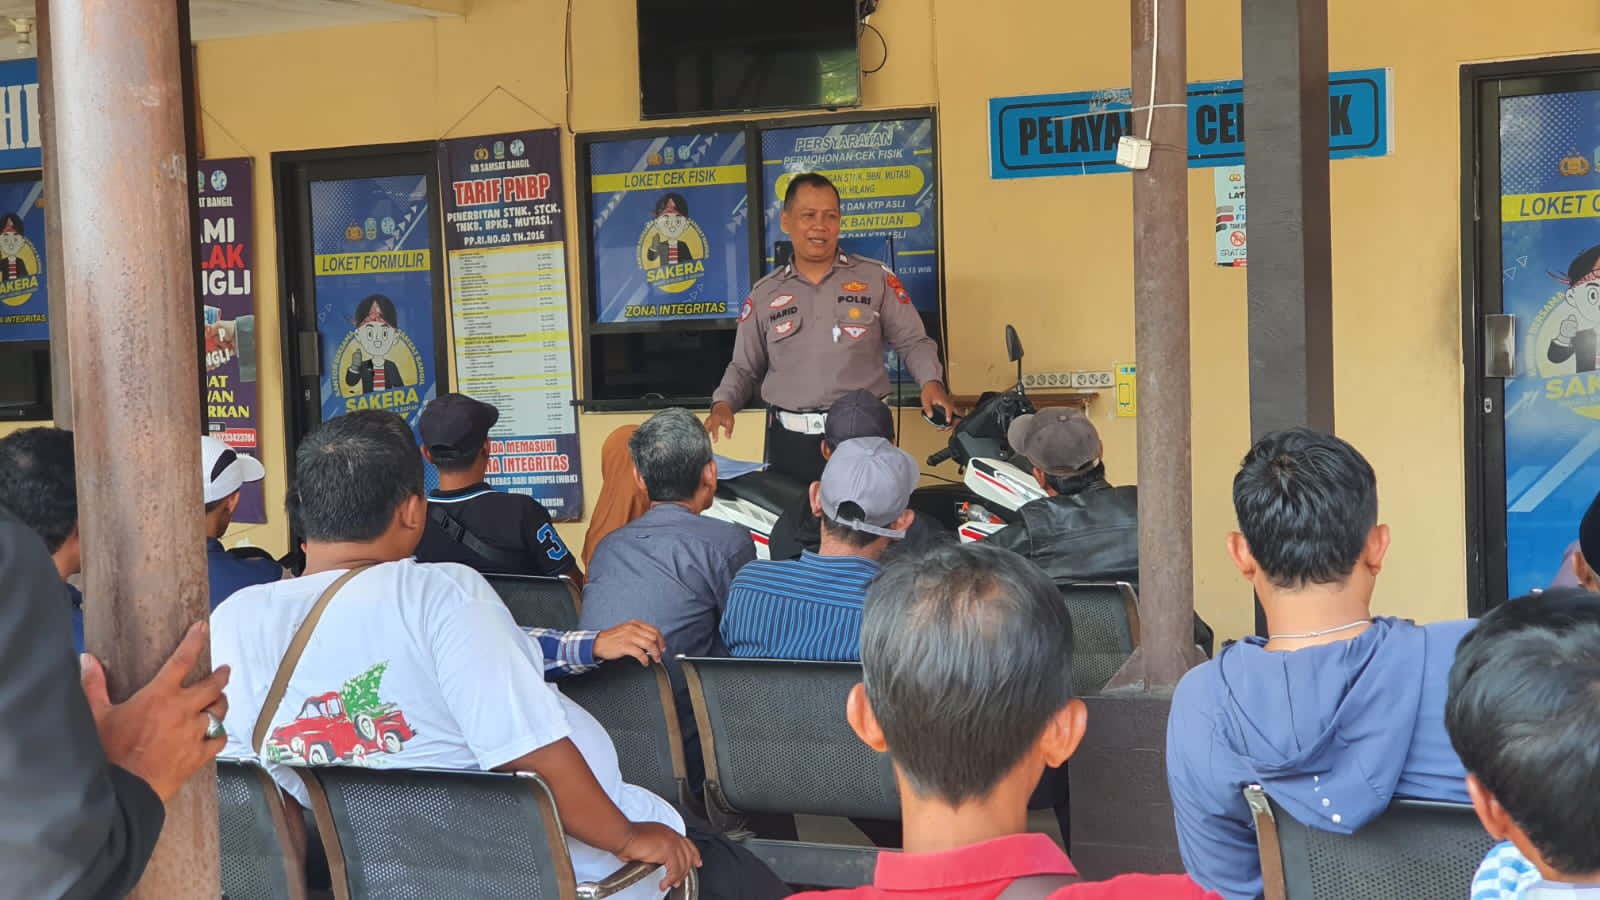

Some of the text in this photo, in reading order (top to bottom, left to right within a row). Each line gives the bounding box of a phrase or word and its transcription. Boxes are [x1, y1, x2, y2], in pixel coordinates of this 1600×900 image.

[795, 131, 894, 153] PERSYARATAN
[783, 148, 904, 166] PERMOHONAN CEK FISIK
[624, 169, 717, 188] LOKET CEK FISIK
[453, 173, 550, 207] TARIF PNBP
[1520, 194, 1587, 217] LOKET
[447, 209, 500, 223] PENERBITAN
[851, 215, 904, 227] BANTUAN
[322, 252, 425, 273] LOKET FORMULIR
[647, 260, 705, 283] SAKERA
[624, 302, 727, 318] ZONA INTEGRITAS
[838, 295, 872, 306] POLRI
[207, 375, 229, 389] AT
[345, 387, 419, 413] SAKERA
[506, 439, 557, 454] MEMASUKI
[503, 454, 570, 474] INTEGRITAS
[536, 522, 568, 561] 3
